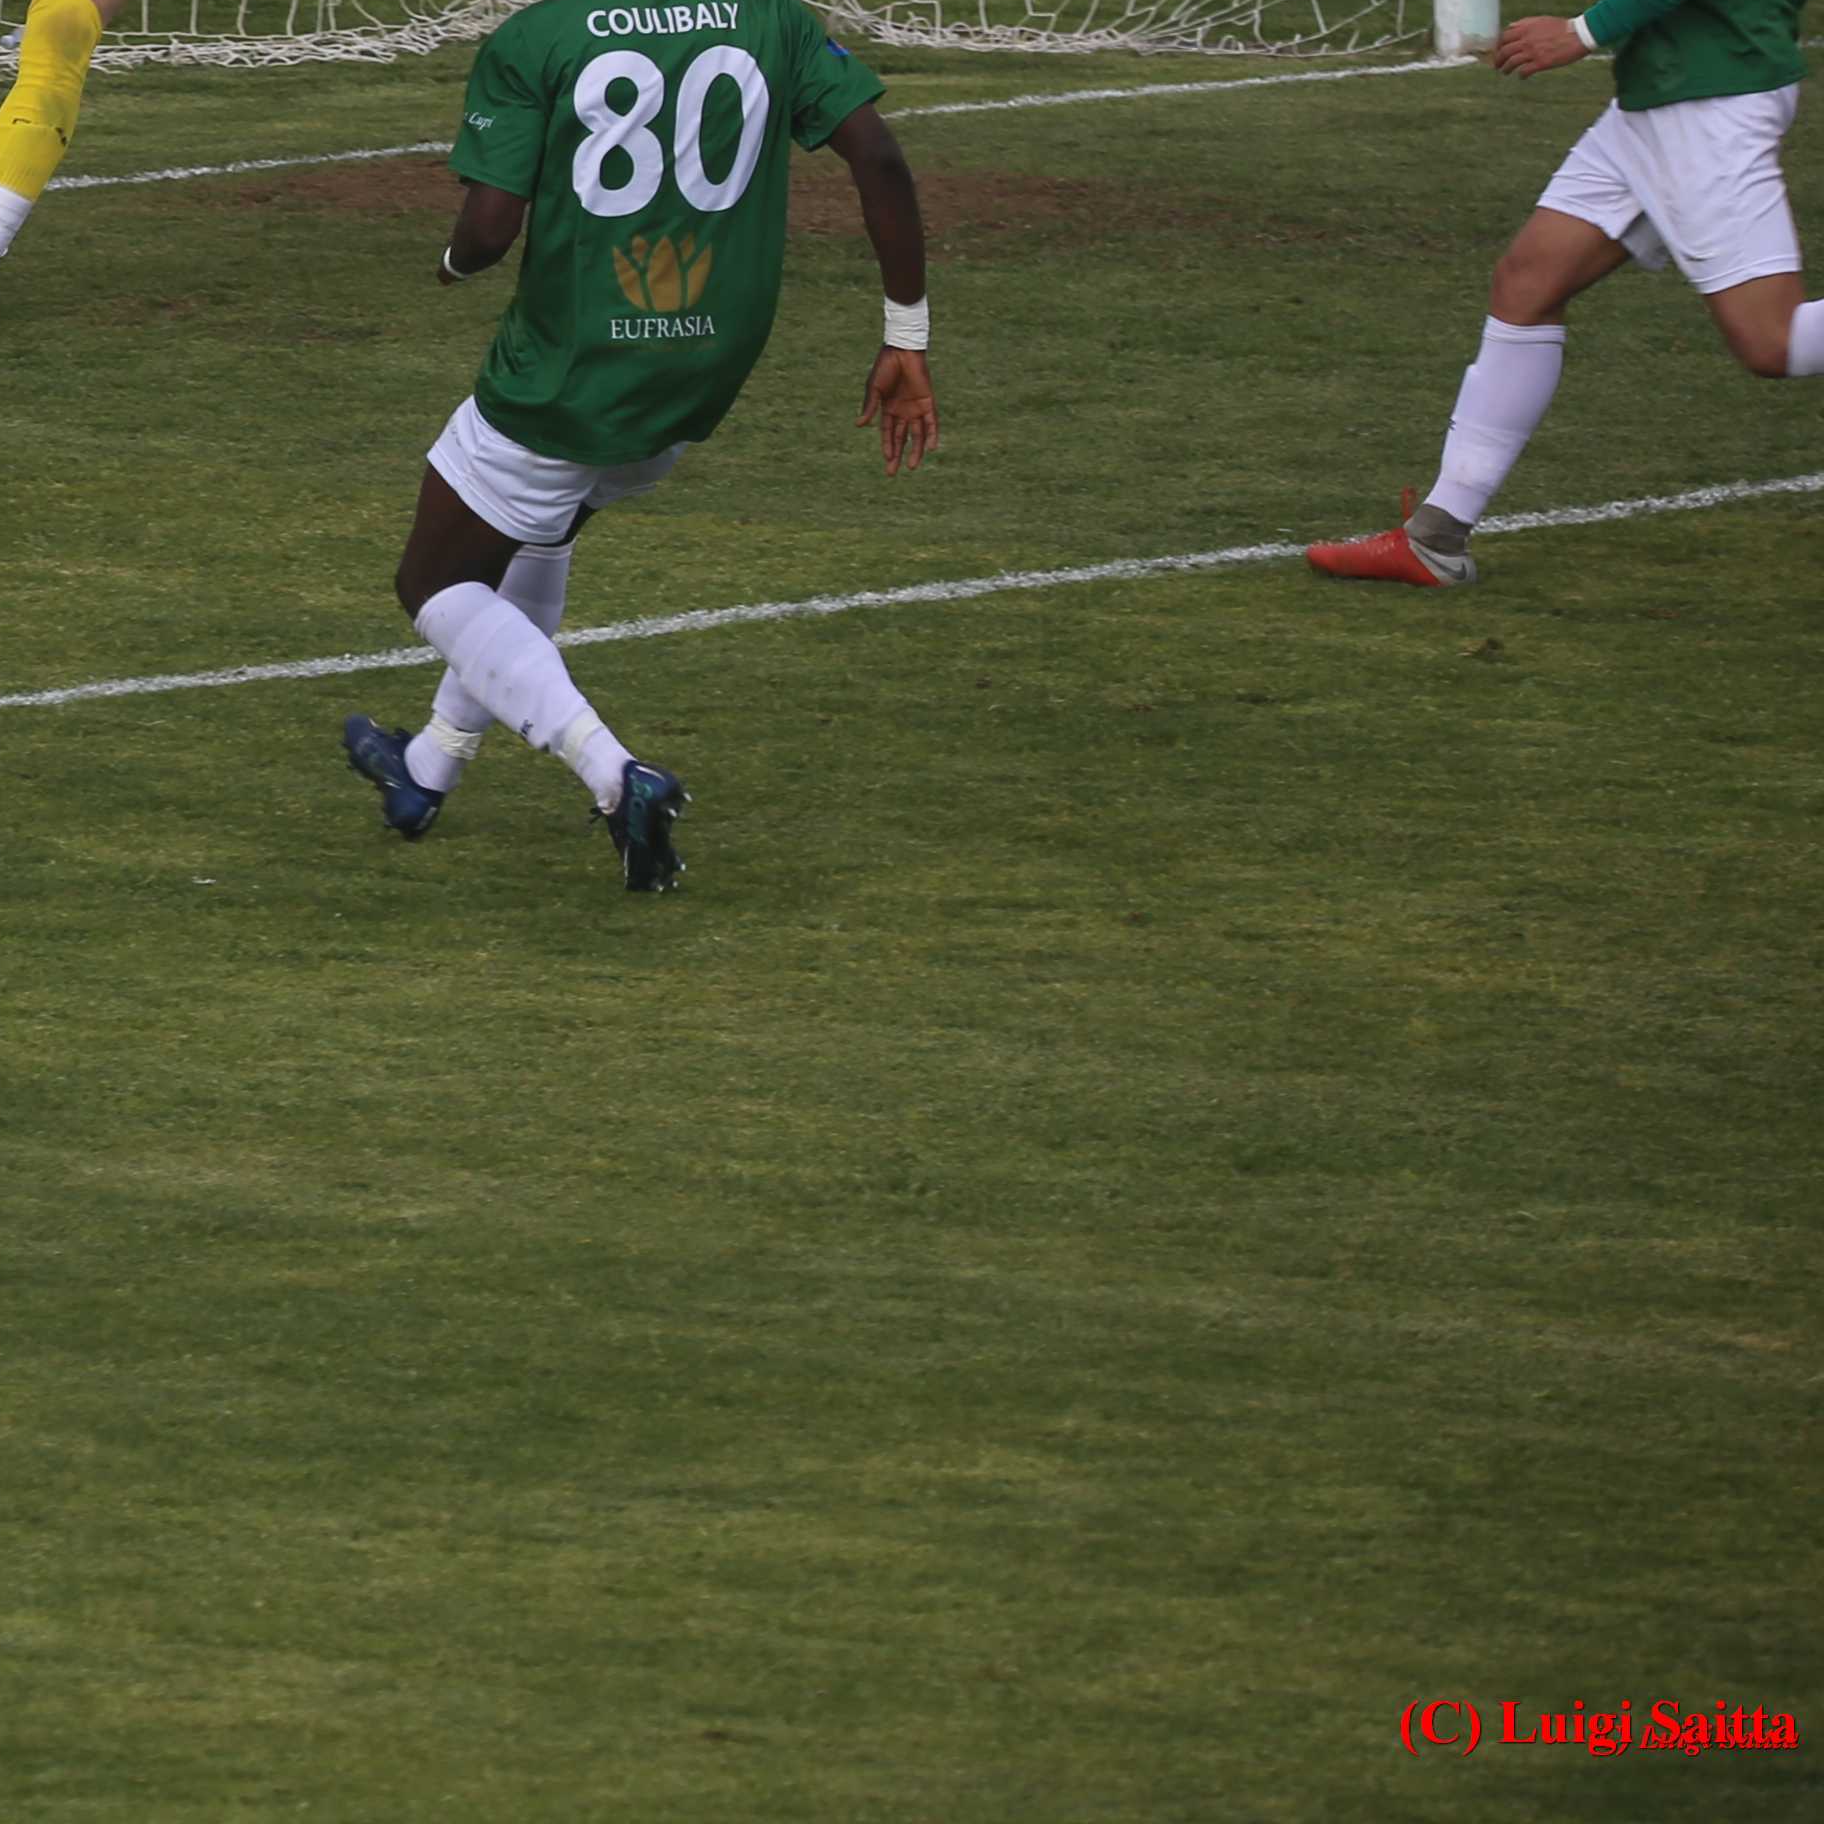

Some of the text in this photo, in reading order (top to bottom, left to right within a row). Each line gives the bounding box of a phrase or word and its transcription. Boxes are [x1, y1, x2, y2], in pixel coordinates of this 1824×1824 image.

[586, 2, 739, 38] COULIBALY
[571, 44, 771, 218] 80
[610, 315, 716, 339] EUFRASIA
